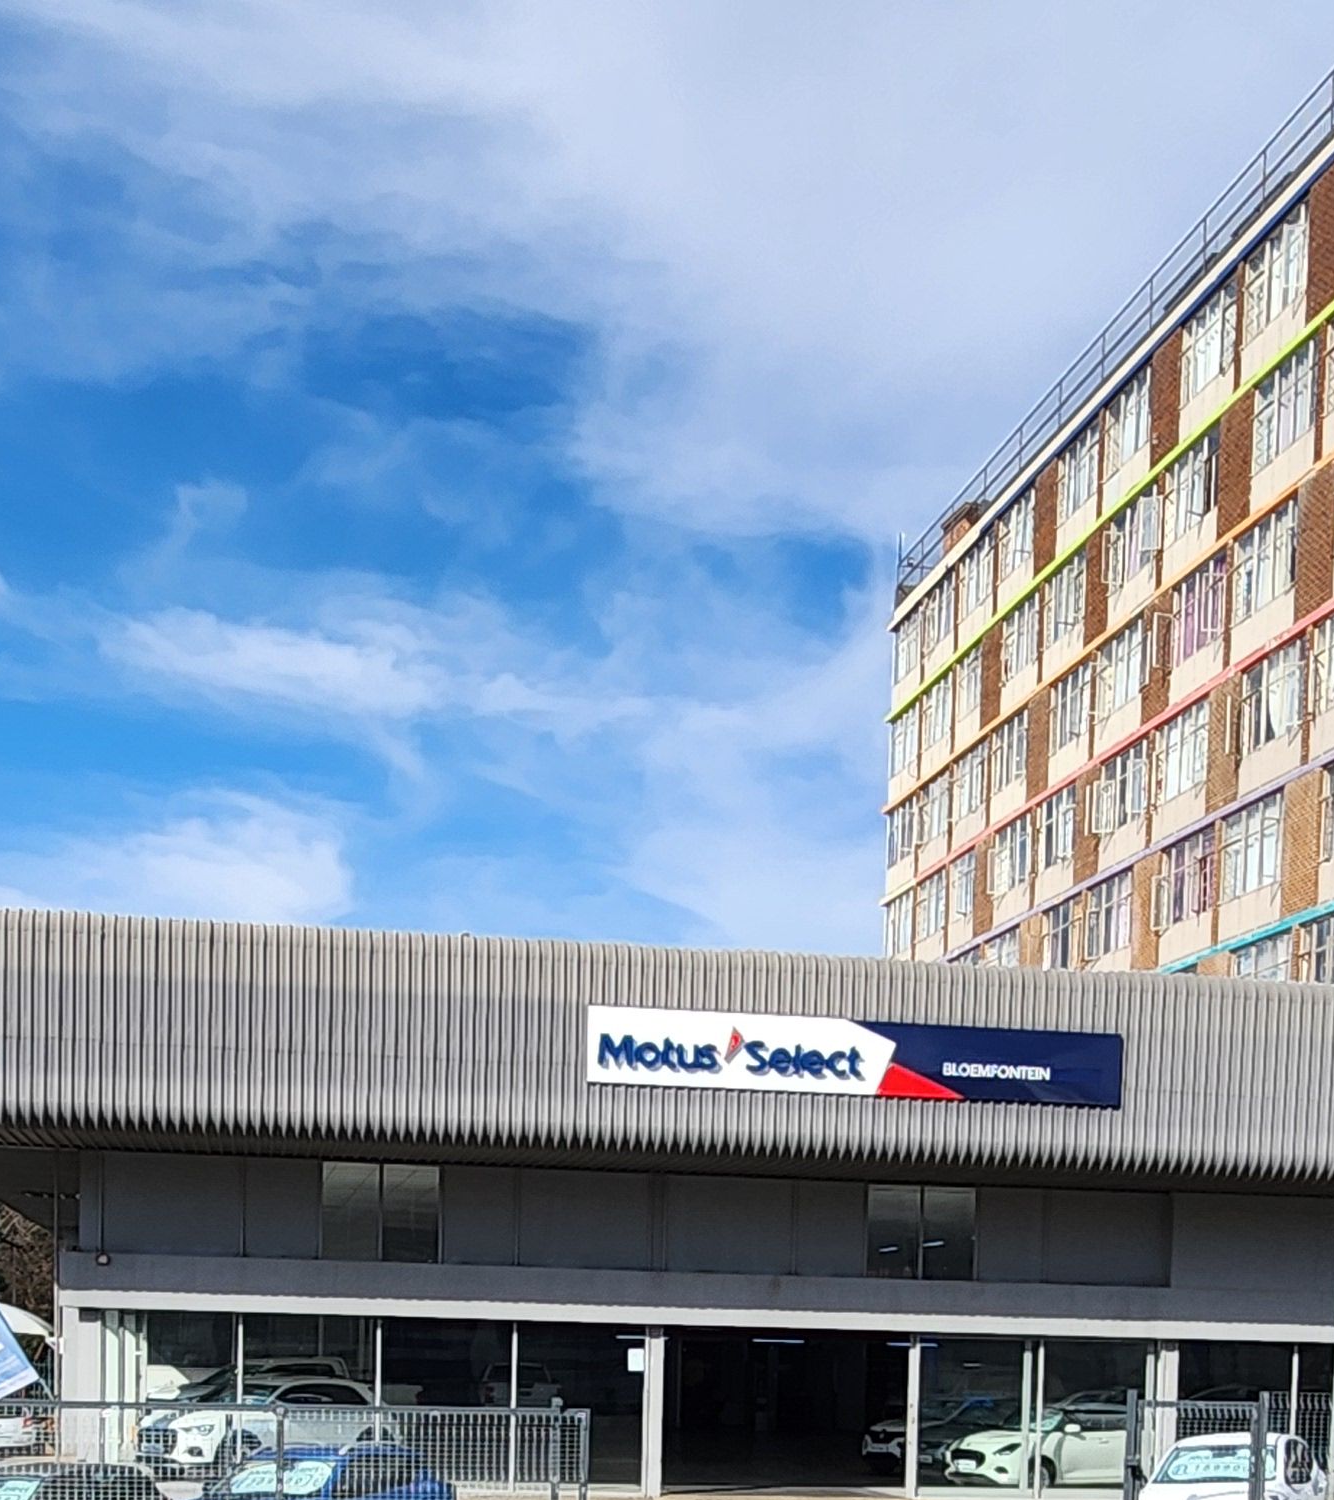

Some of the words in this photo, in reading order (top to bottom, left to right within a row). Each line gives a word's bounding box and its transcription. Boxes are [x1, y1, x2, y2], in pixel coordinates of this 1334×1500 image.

[597, 1032, 720, 1073] Motus
[744, 1040, 864, 1080] Select
[942, 1062, 1050, 1081] BLOEMFONTEIN
